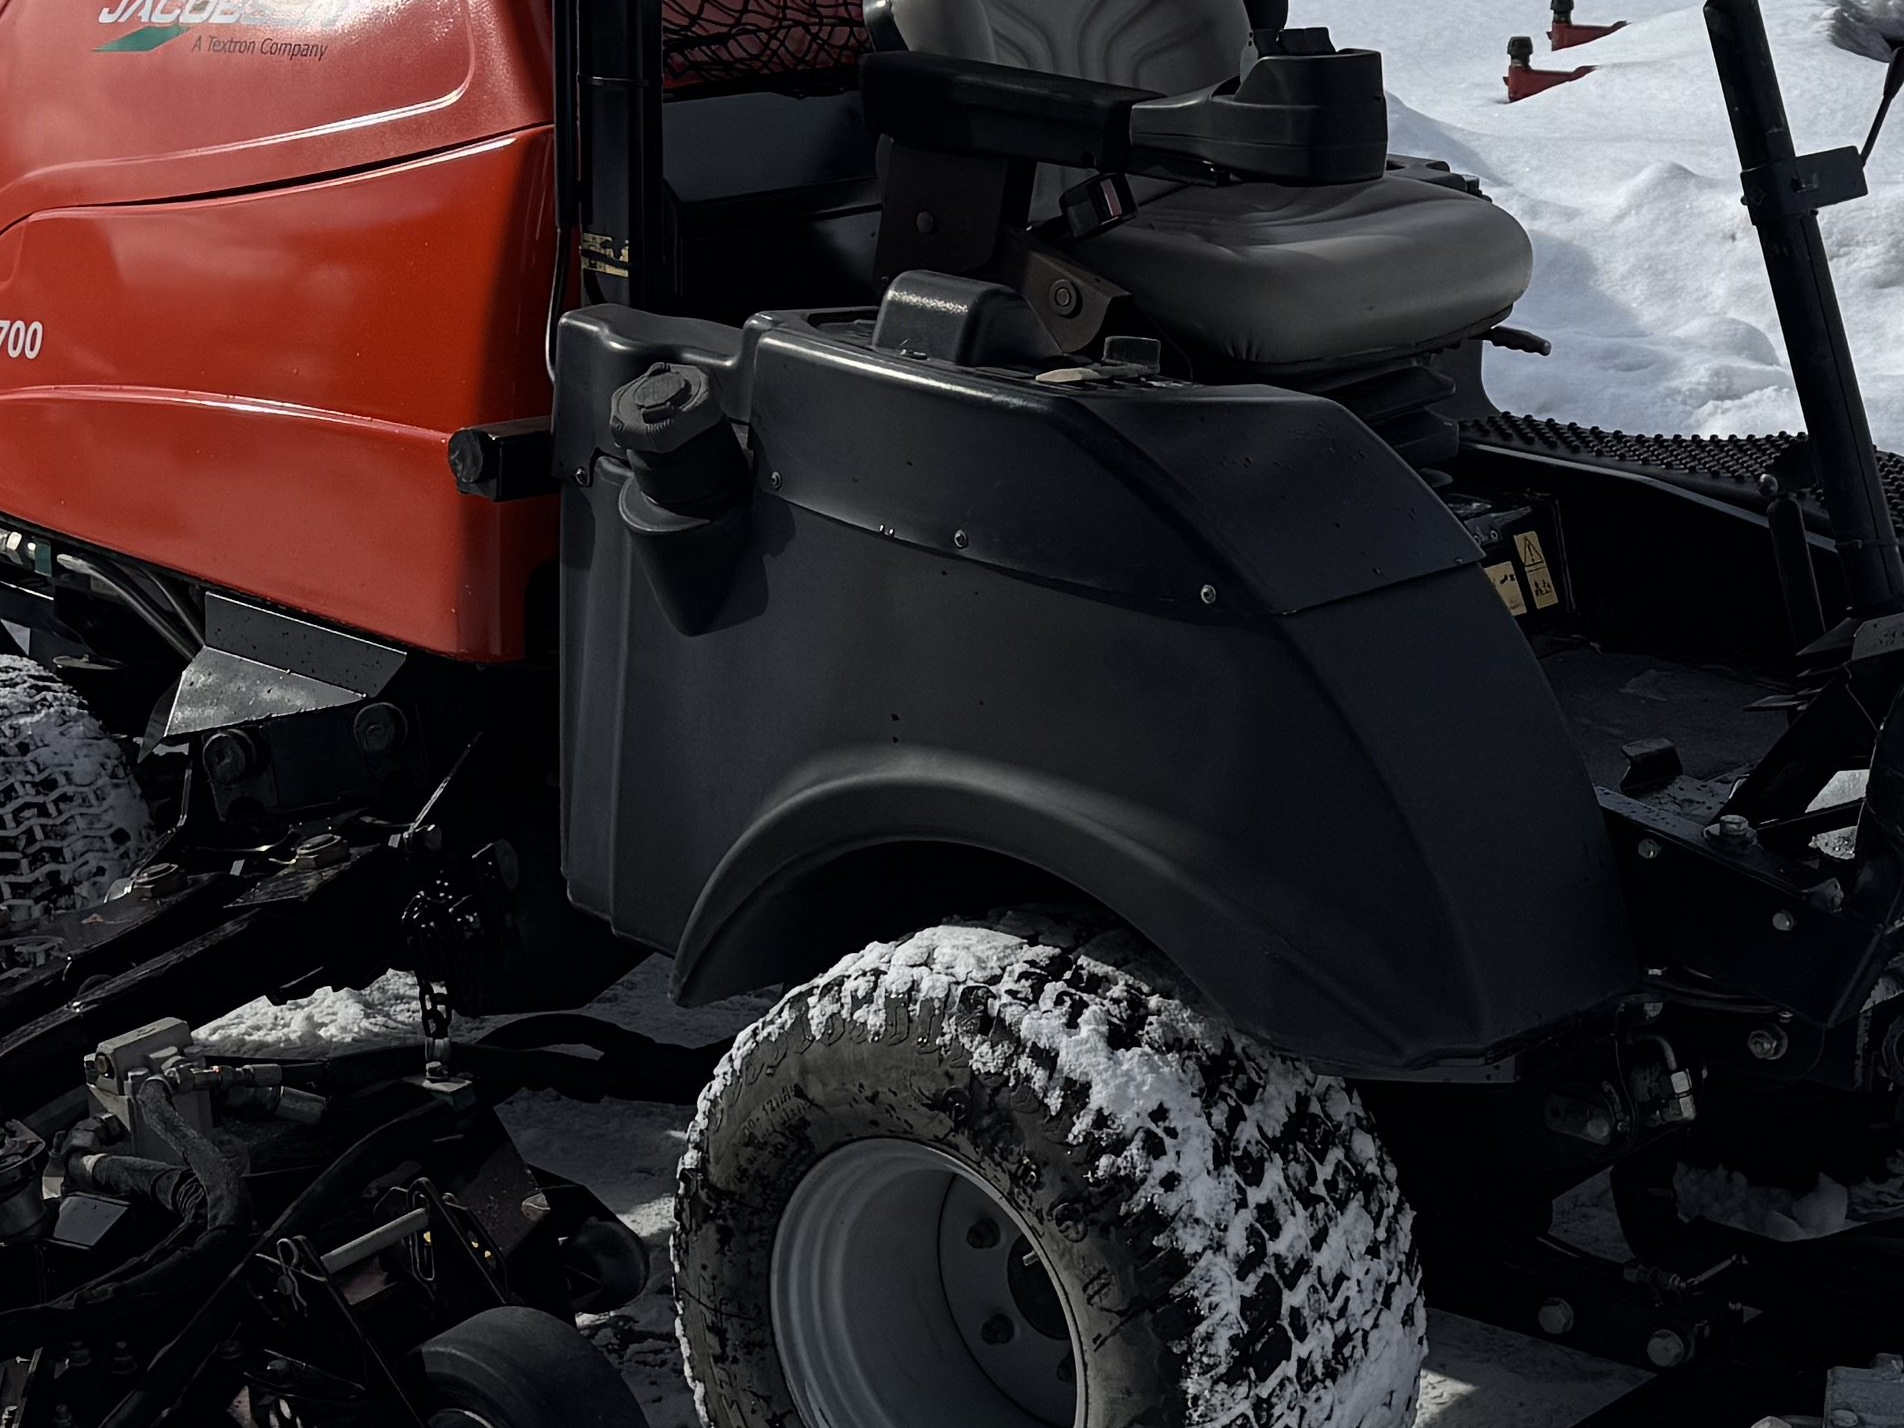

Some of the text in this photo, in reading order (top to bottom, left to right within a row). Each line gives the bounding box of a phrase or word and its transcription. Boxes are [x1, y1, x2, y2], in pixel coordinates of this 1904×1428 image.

[191, 37, 329, 62] A Textron Company
